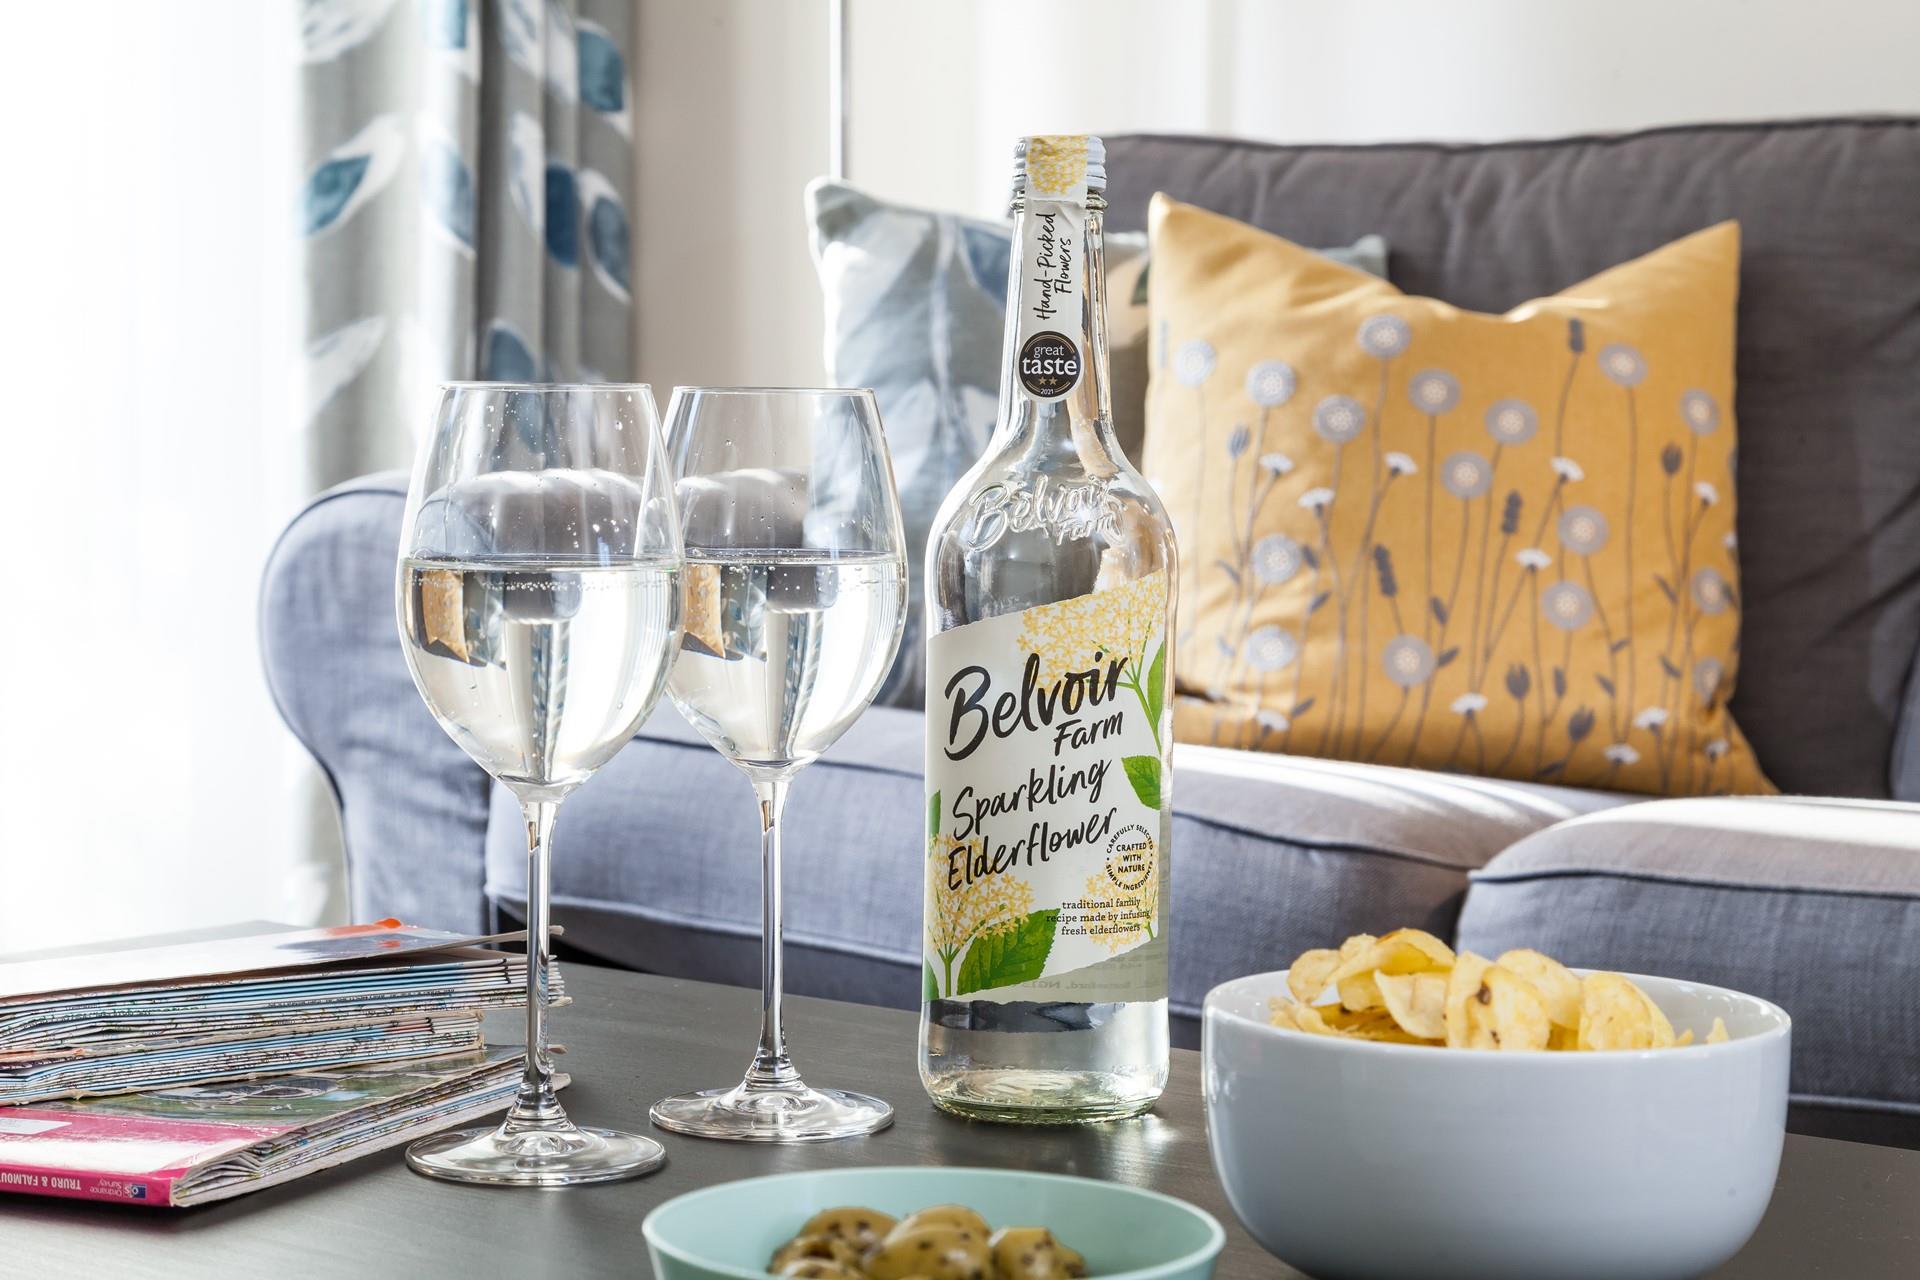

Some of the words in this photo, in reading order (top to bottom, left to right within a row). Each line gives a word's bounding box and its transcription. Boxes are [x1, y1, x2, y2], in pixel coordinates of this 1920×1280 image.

[1033, 213, 1057, 320] Hand-Picked
[1054, 237, 1072, 294] Flowers
[1033, 345, 1065, 359] great
[1022, 357, 1077, 376] taste
[944, 651, 1128, 761] Belvoir
[1053, 711, 1123, 756] Farm
[952, 759, 1112, 840] Sparkling
[1106, 824, 1135, 854] CAREFULLY
[1136, 824, 1154, 850] SELECTED
[948, 807, 1117, 891] Elderflower
[1116, 842, 1147, 852] CRAFTED
[1122, 854, 1142, 862] WITH
[1106, 864, 1122, 887] SIMPLE
[1117, 864, 1146, 873] NATURE
[1062, 899, 1113, 909] traditional
[1115, 897, 1141, 909] family
[1046, 913, 1077, 924] recipe
[1080, 912, 1106, 922] made
[1108, 912, 1119, 922] by
[1120, 908, 1151, 919] infusing
[1061, 926, 1087, 935] fresh
[1089, 923, 1141, 935] elderflowers
[0, 1172, 39, 1186] FALMOU
[42, 1176, 49, 1187] &
[51, 1177, 82, 1190] TRURO
[98, 1178, 122, 1190] Survey
[90, 1186, 122, 1197] Ordnance
